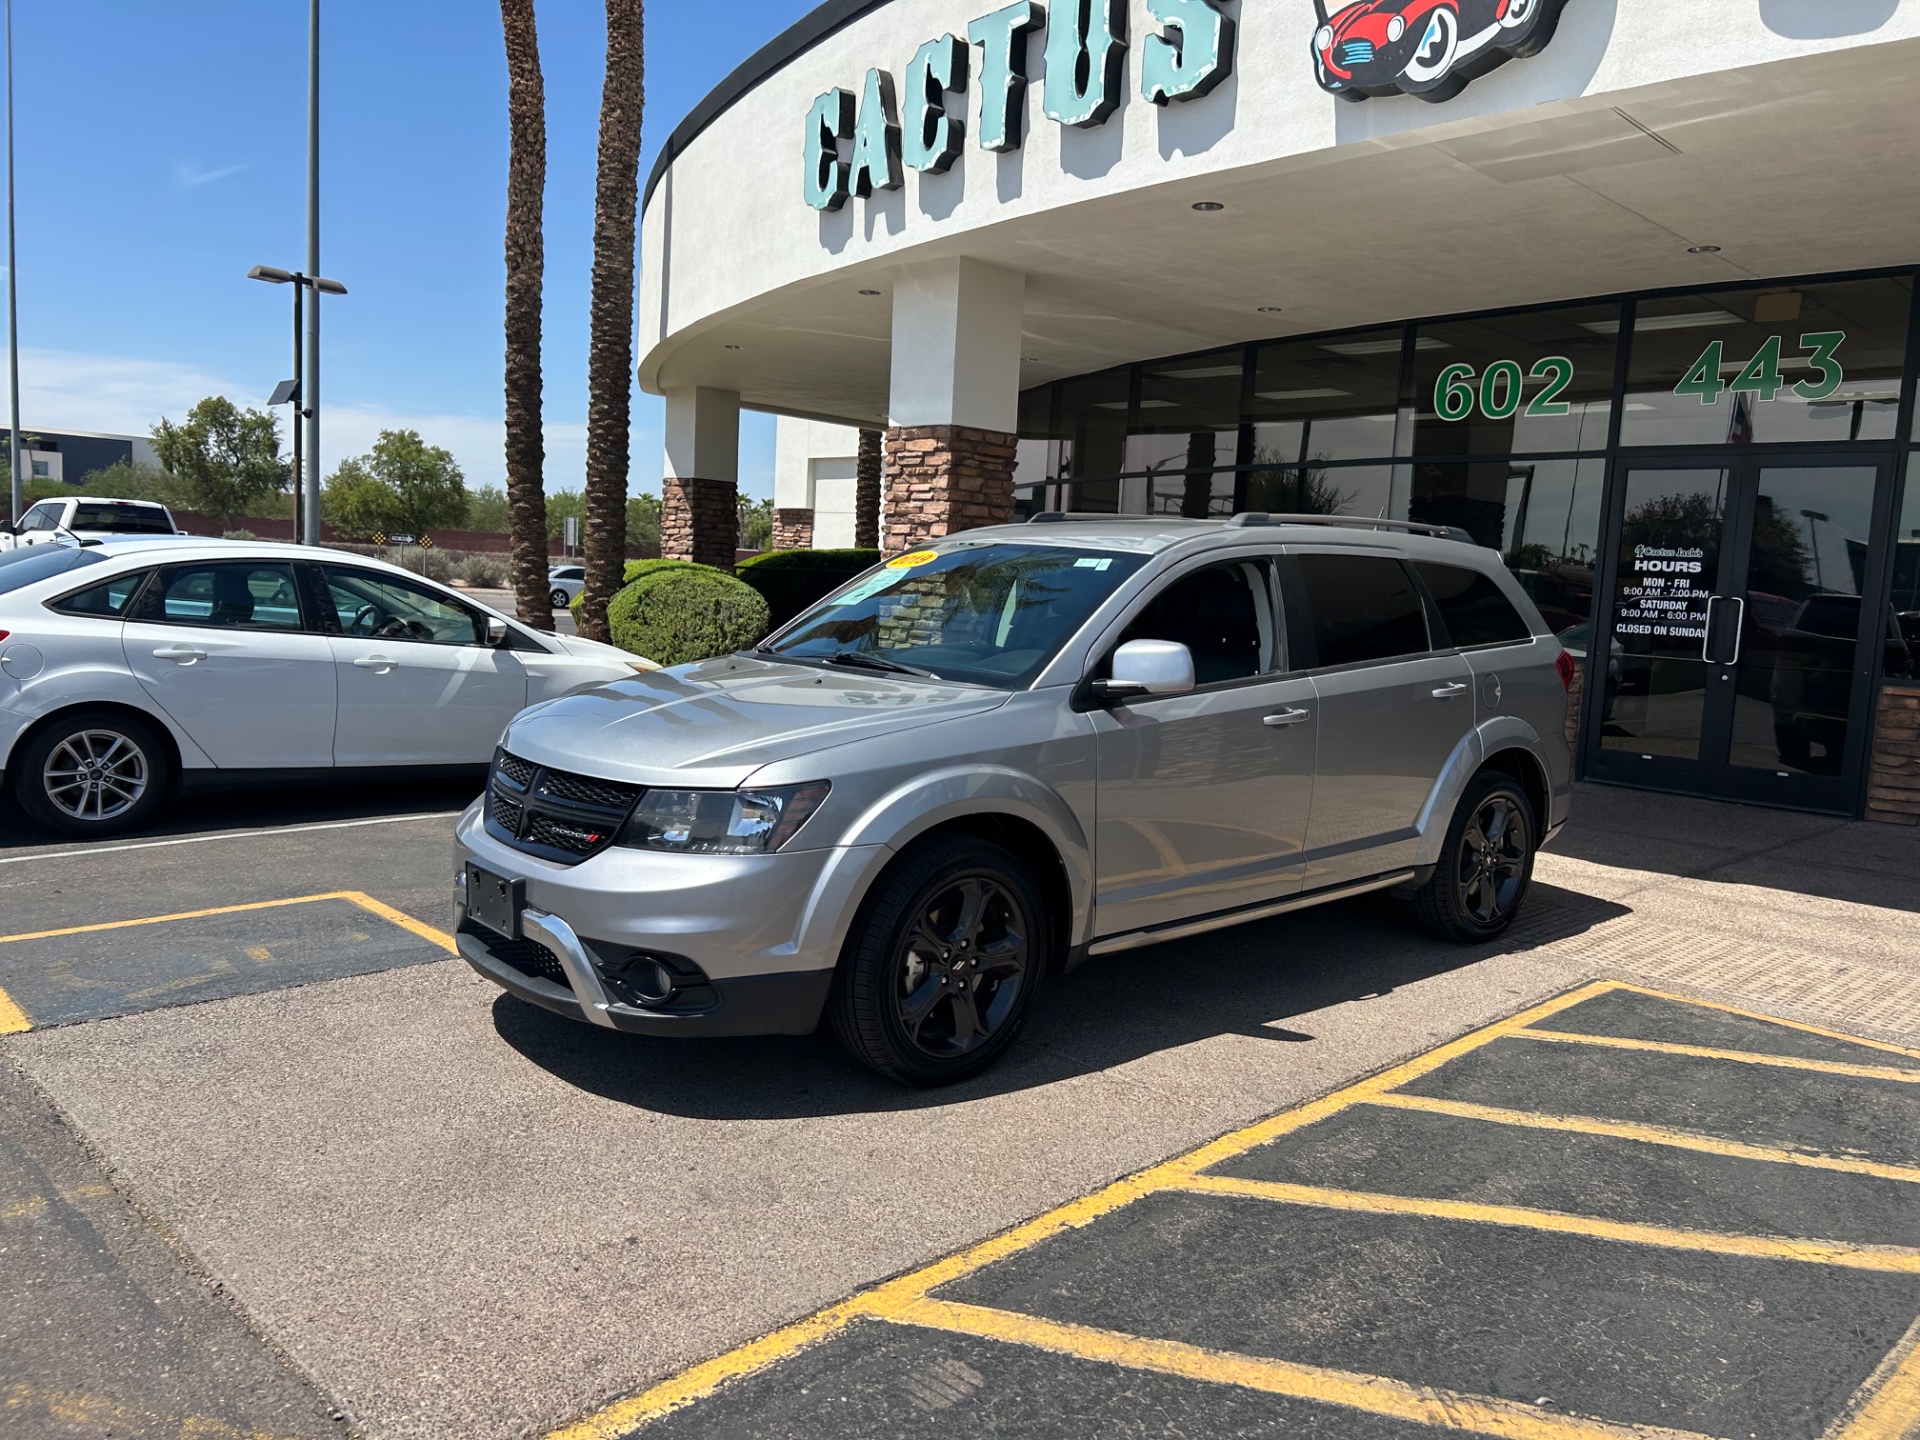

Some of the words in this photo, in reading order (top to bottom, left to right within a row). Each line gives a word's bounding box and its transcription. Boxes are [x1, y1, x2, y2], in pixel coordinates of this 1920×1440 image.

[803, 0, 1235, 211] CACTUS
[1433, 356, 1575, 421] 602
[1673, 330, 1847, 405] 443
[1644, 546, 1676, 557] Cactus
[1675, 547, 1703, 558] Jack's
[889, 554, 935, 566] 2019
[1634, 560, 1702, 573] HOURS
[1643, 577, 1665, 588] MON
[1674, 579, 1690, 588] FRI
[1623, 587, 1643, 595] 9:00
[1644, 588, 1661, 596] AM
[1670, 589, 1690, 597] 7:00
[1692, 590, 1709, 598] PM
[1640, 599, 1688, 610] SATURDAY
[1621, 608, 1641, 617] 9:00
[1642, 610, 1658, 618] AM
[1667, 611, 1687, 620] 6:00
[1689, 612, 1706, 621] PM
[1616, 623, 1651, 635] CLOSED
[1653, 626, 1667, 635] ON
[1669, 627, 1706, 638] SUNDAY
